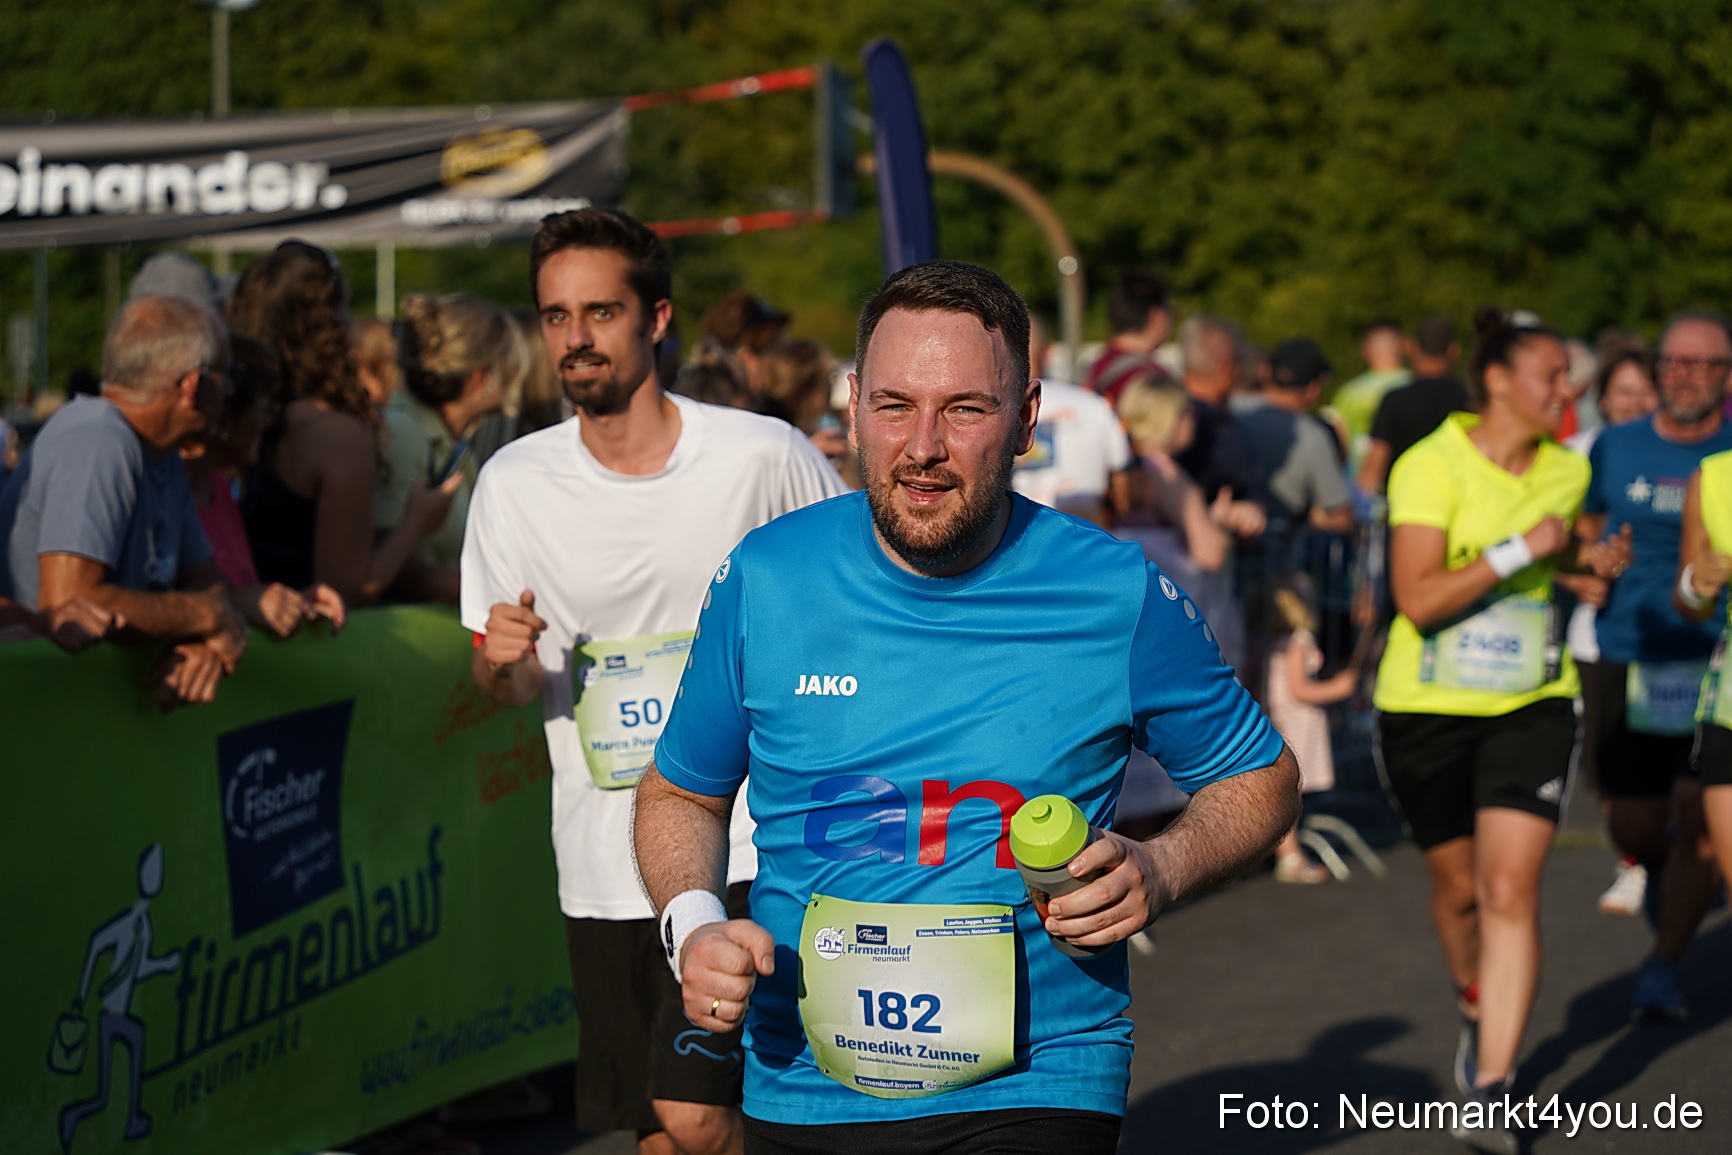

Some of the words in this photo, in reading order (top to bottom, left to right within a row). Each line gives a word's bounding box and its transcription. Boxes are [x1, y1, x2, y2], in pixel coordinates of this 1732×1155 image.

[795, 674, 858, 696] JAKO
[243, 768, 326, 824] Fischer
[176, 824, 443, 1060] firmenlauf
[847, 944, 911, 956] Firmenlauf
[872, 955, 911, 963] neumarkt
[857, 988, 942, 1034] 182
[834, 1034, 912, 1058] Benedikt
[916, 1044, 981, 1064] Zunner
[173, 1019, 300, 1113] neumarkt
[858, 1077, 920, 1090] firmenlauf.bayern
